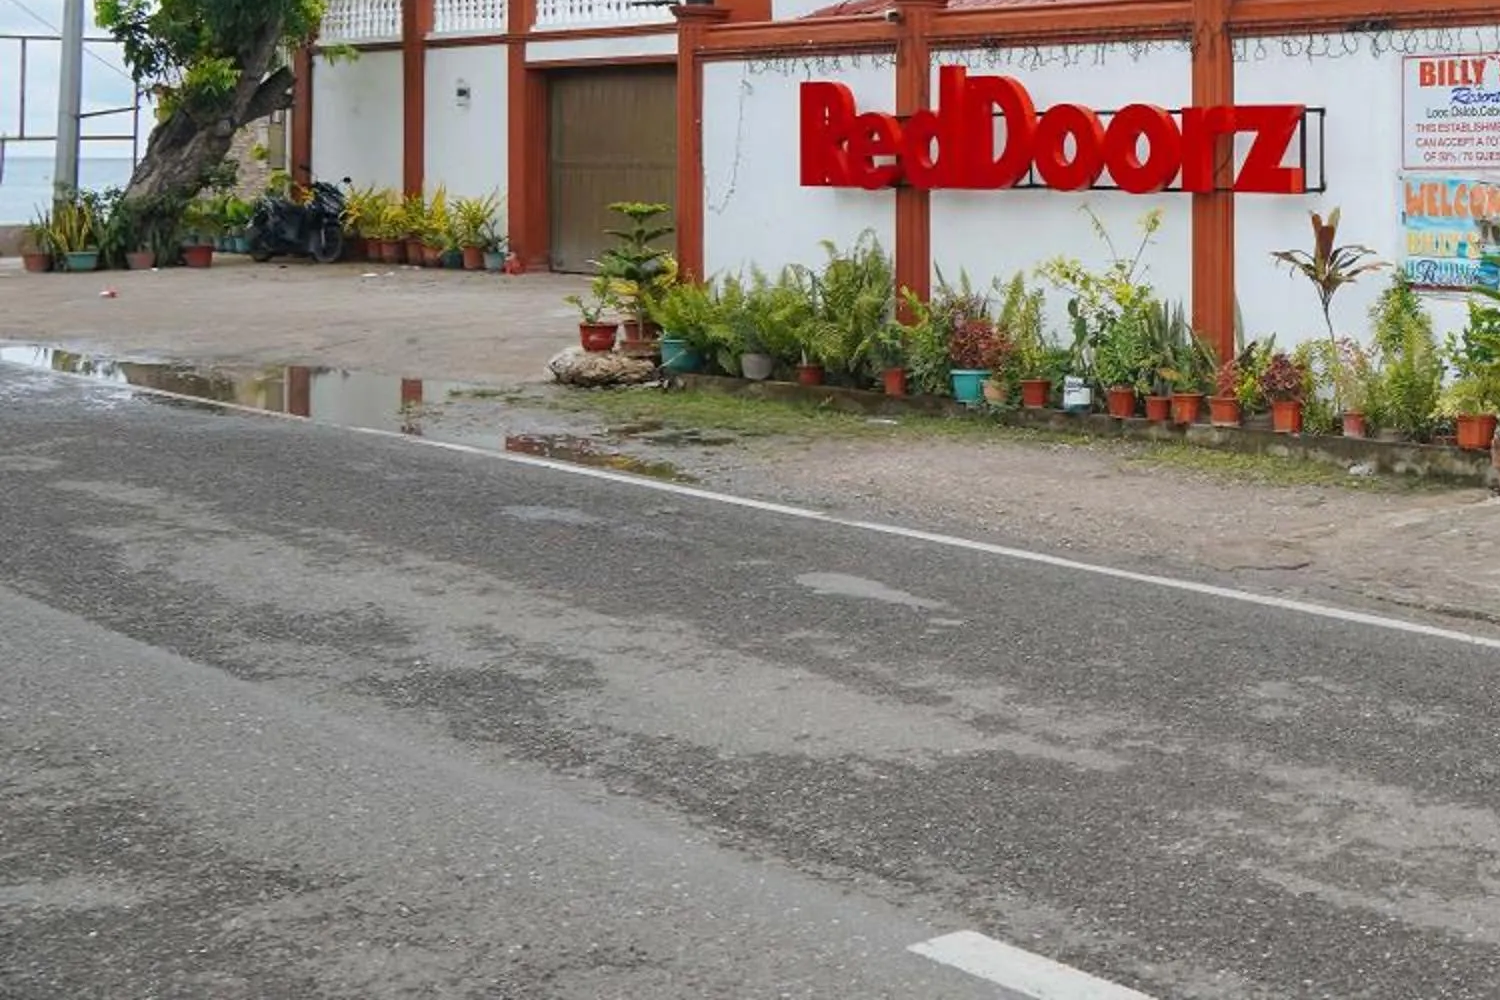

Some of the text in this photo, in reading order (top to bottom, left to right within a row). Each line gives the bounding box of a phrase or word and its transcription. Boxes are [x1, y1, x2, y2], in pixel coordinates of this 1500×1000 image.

[800, 65, 1305, 194] RedDoorz
[1415, 123, 1436, 133] THIS
[1415, 137, 1437, 148] CAN
[1438, 137, 1475, 147] ACCEPT
[1476, 136, 1484, 147] A
[1424, 151, 1437, 161] OF
